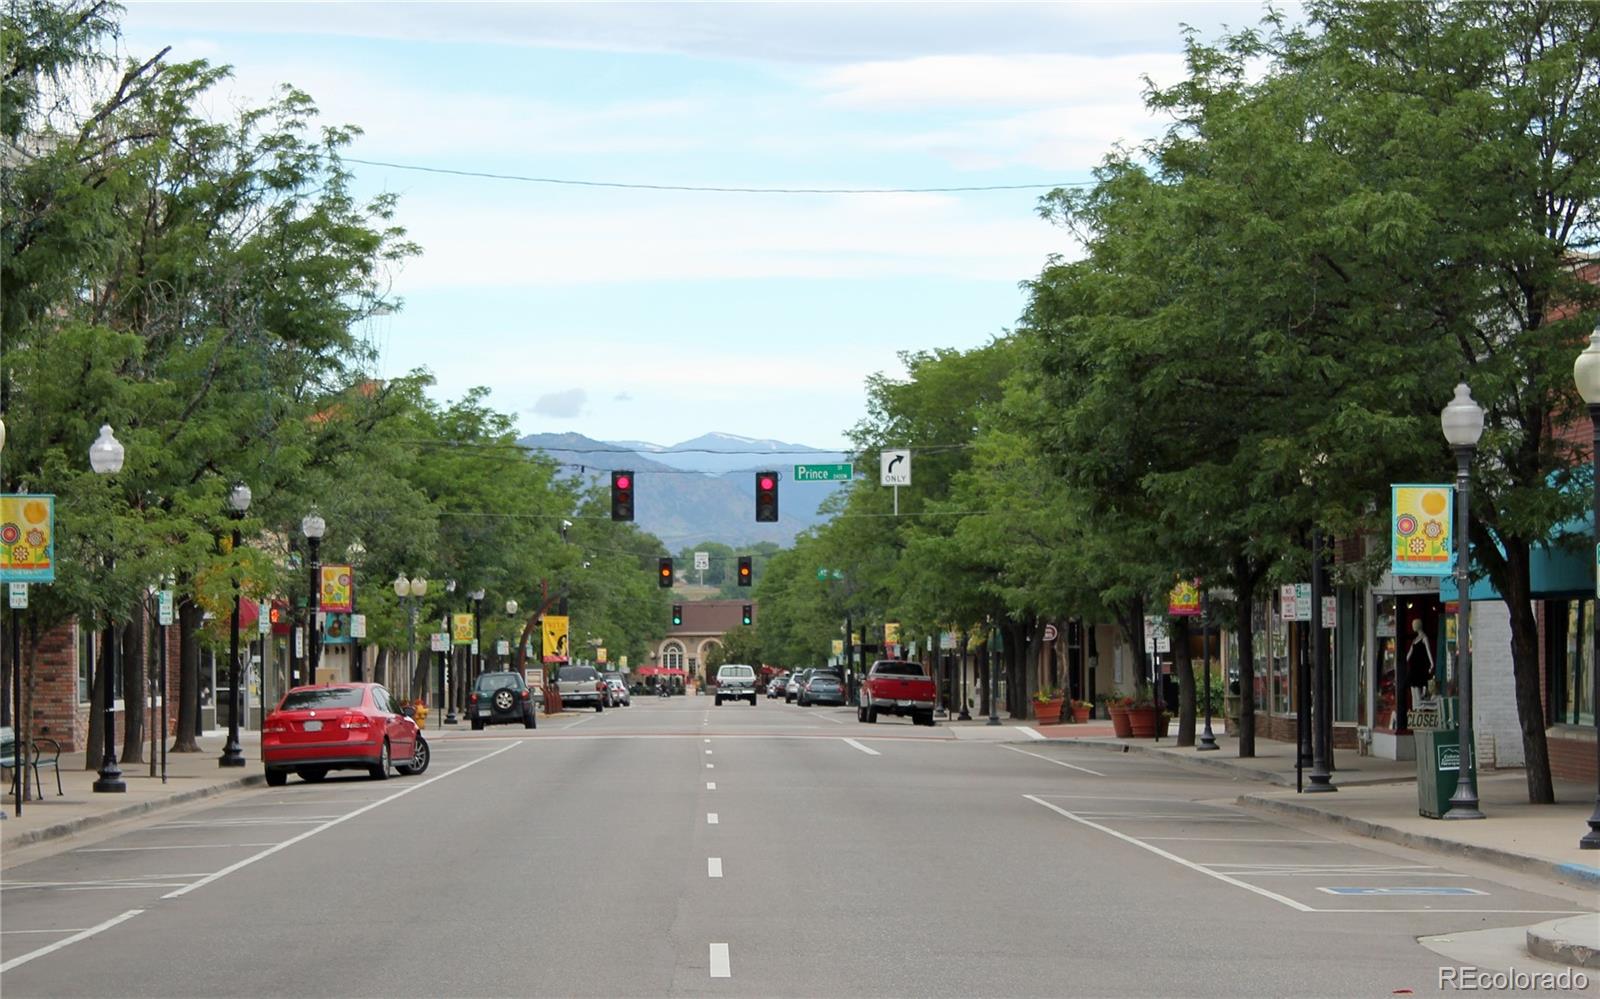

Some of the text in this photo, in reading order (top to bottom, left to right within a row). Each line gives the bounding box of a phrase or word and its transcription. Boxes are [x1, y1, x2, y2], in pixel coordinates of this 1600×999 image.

[798, 466, 829, 480] Prince
[885, 475, 907, 483] ONLY
[1407, 713, 1439, 728] CLOSED
